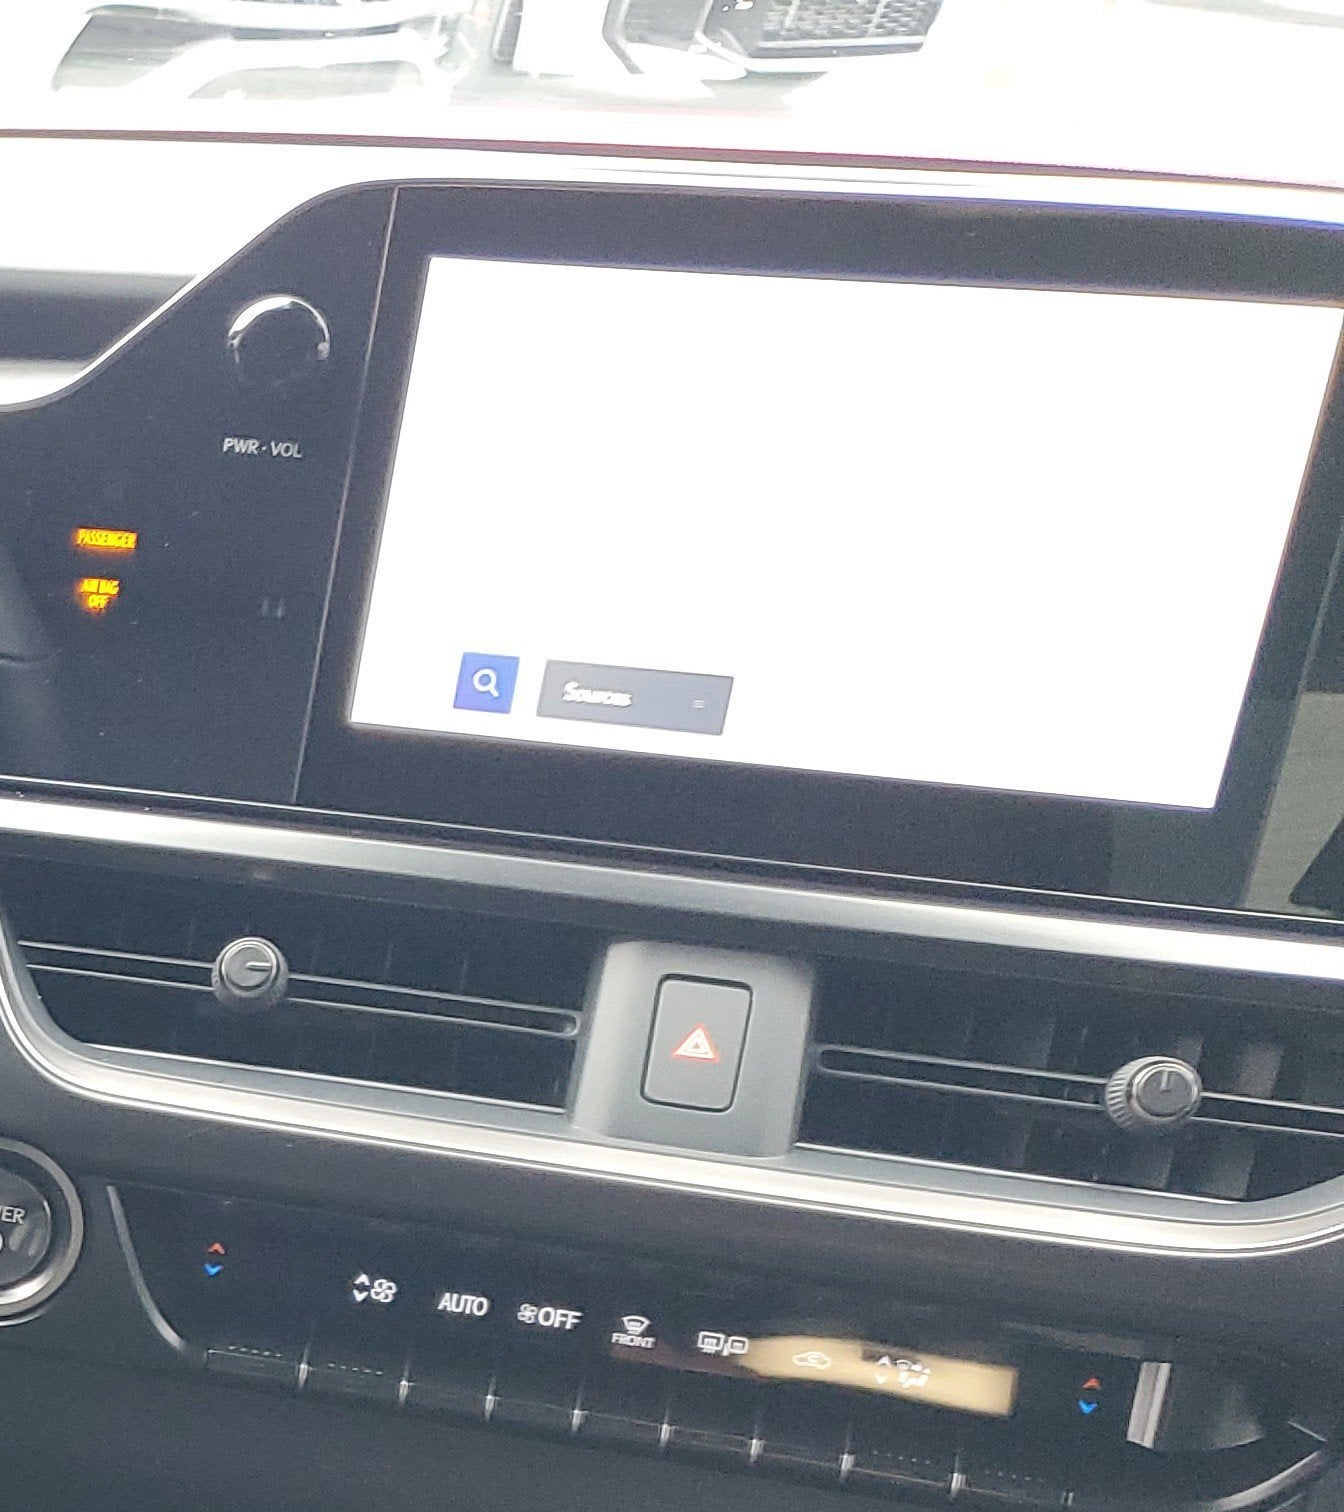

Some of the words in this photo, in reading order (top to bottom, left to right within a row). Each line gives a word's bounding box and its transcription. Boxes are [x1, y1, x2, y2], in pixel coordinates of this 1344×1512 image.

[222, 437, 259, 456] PWR
[270, 441, 304, 458] VOL
[438, 1291, 490, 1318] AUTO
[537, 1307, 583, 1330] OFF
[611, 1332, 656, 1349] FRONT
